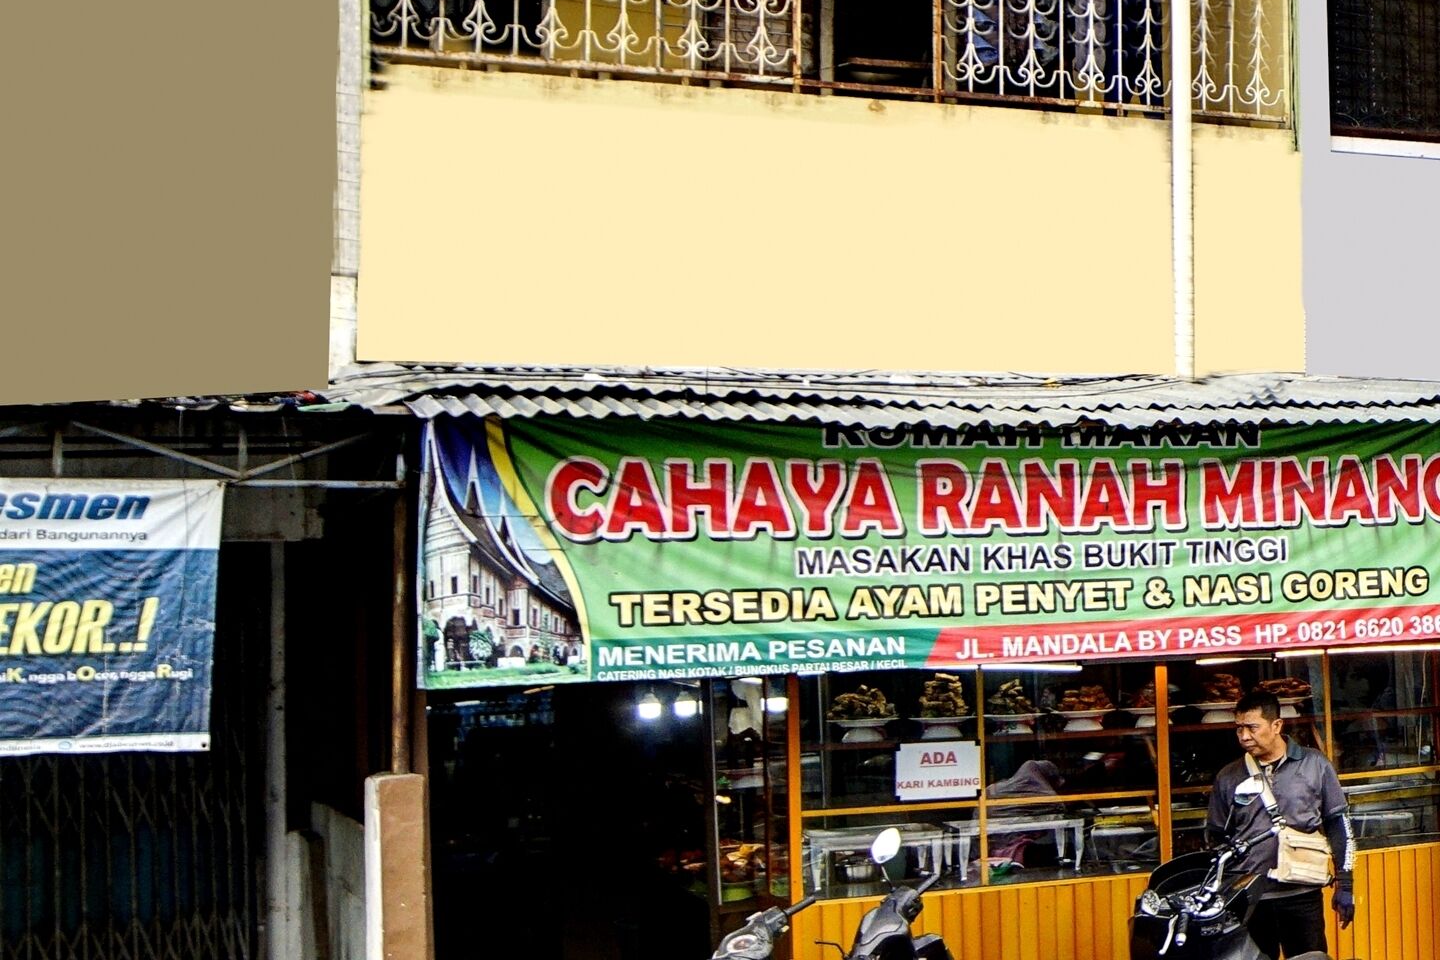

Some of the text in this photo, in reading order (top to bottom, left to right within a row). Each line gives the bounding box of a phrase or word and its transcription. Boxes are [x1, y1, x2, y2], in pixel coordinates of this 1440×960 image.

[0, 491, 150, 520] smen
[546, 456, 906, 541] CAHAYA
[917, 456, 1188, 536] RANAH
[36, 528, 148, 542] Bangunannya
[797, 538, 1287, 578] MASAKAN KHAS BUKIT TINGGI
[609, 566, 1430, 626] TERSEDIA AYAM PENYET & NASI GORENG
[598, 636, 905, 667] MENERIMA PESANAN
[956, 638, 994, 659] JL.
[1002, 633, 1131, 658] MANDALA
[1138, 631, 1172, 651] BY
[1178, 626, 1242, 649] PASS
[1256, 624, 1291, 646] HP.
[1298, 621, 1347, 643] 0821
[1354, 617, 1404, 638] 6620
[156, 663, 194, 681] Rugi
[598, 669, 656, 682] CATERING
[657, 669, 686, 680] NASI
[688, 666, 726, 678] KOTAK
[735, 664, 790, 676] BUNGKUS
[792, 663, 831, 674] PARTAI
[833, 661, 868, 672] BESAR
[876, 659, 908, 671] KECIL
[920, 751, 957, 765] ADA
[897, 777, 980, 790] KARI KAMBING
